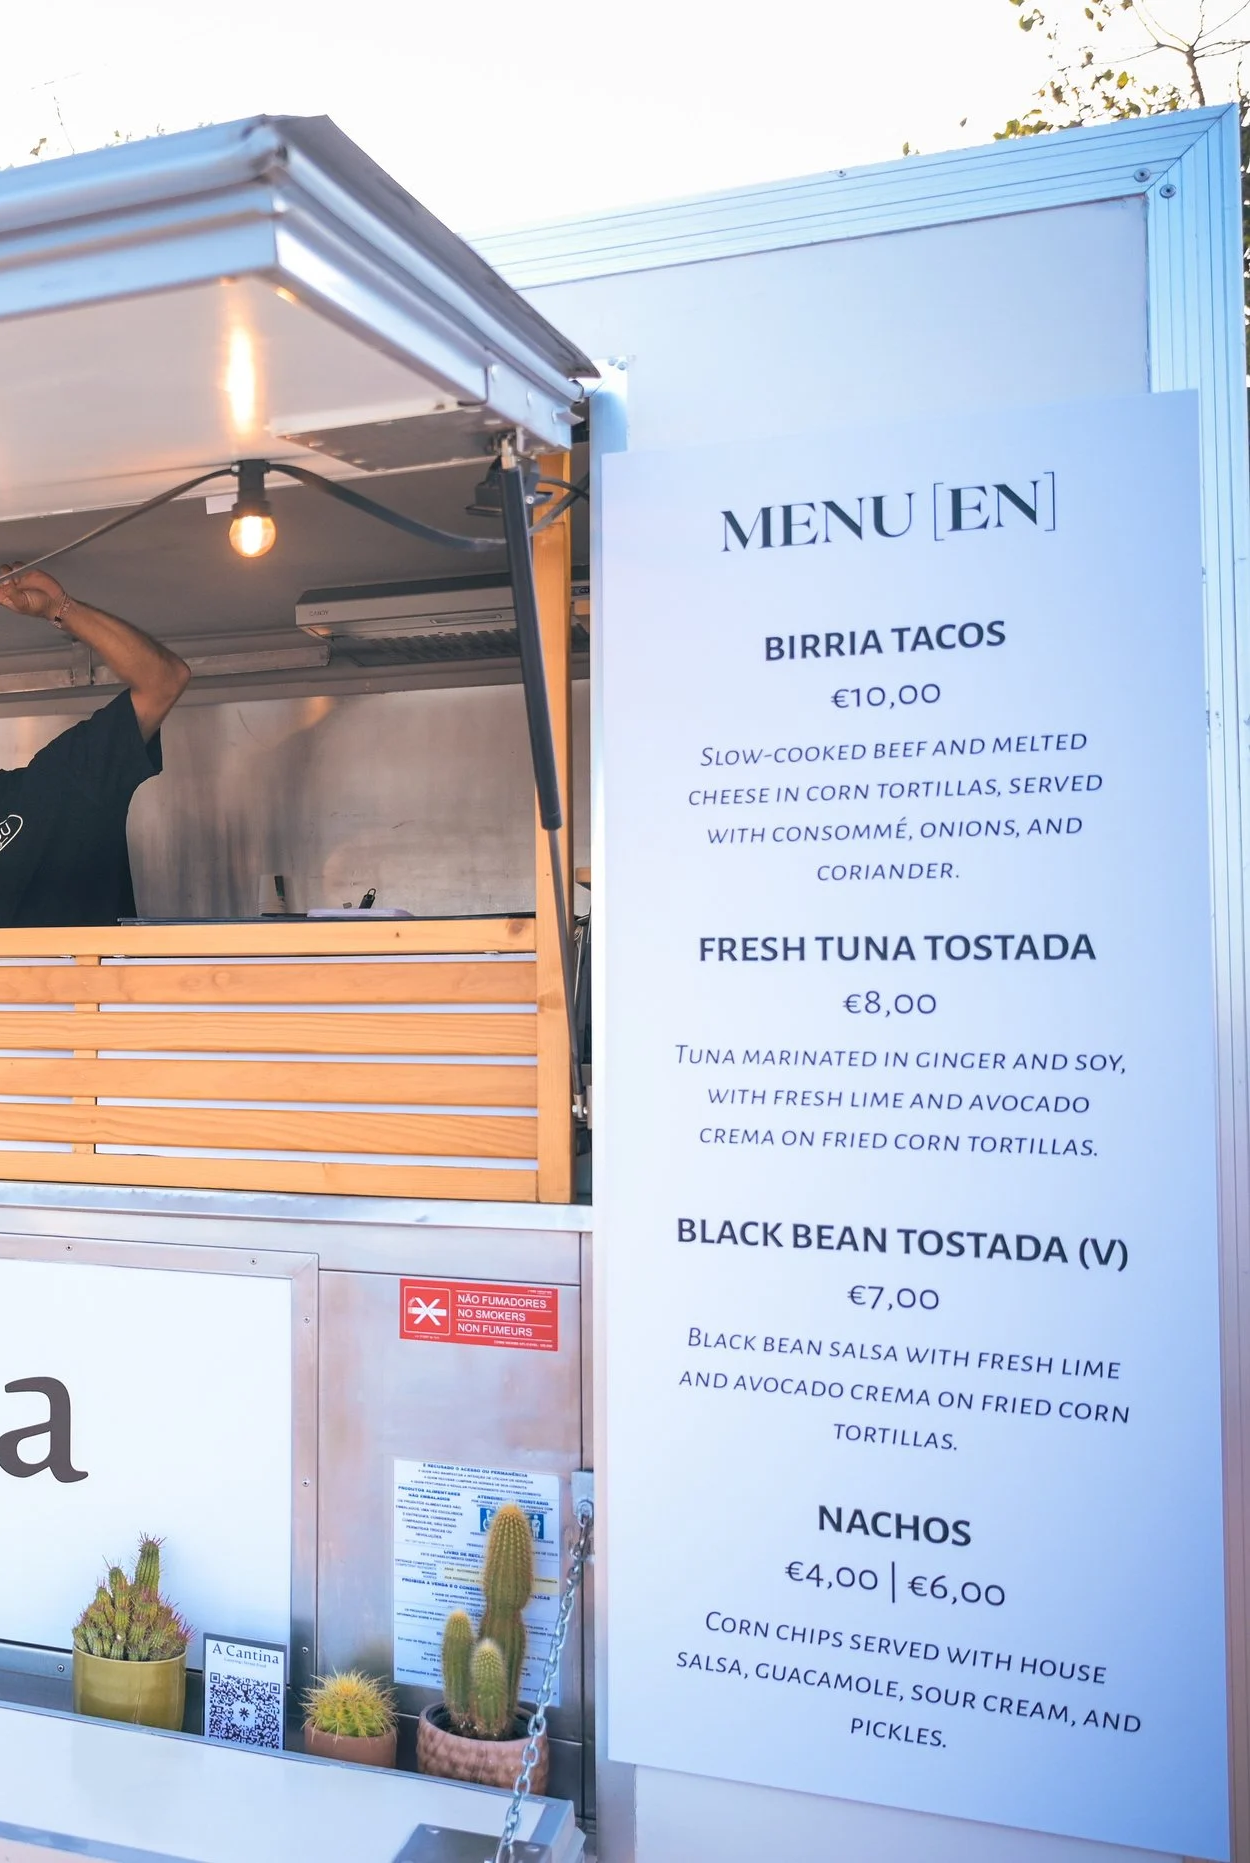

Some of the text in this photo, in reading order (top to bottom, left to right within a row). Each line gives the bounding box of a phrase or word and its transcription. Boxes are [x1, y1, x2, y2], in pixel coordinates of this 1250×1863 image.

[721, 471, 1056, 552] MENU [EN]
[765, 620, 1006, 661] BIRRIA TACOS
[831, 683, 941, 709] €10,00
[700, 733, 1087, 767] SLOW-COOKED BEEF AND MELTED
[688, 774, 1103, 806] CHEESE IN CORN TORTILLAS, SERVED
[707, 816, 1083, 844] WITH CONSOMMÉ, ONIONS, AND
[817, 862, 959, 881] CORIANDER.
[700, 934, 1096, 962] FRESH TUNA TOSTADA
[843, 990, 936, 1018] €8,00
[675, 1044, 1125, 1075] TUNA MARINATED IN GINGER AND SOY,
[708, 1089, 1090, 1113] WITH FRESH LIME AND AVOCADO
[699, 1128, 1097, 1157] CREMA ON FRIED CORN TORTILLAS.
[678, 1218, 1128, 1272] BLACK BEAN TOSTADA (V)
[457, 1293, 547, 1309] NÃO FUMADORES
[847, 1285, 939, 1311] €7,00
[457, 1310, 526, 1322] NO SMOKERS
[457, 1323, 533, 1337] NON FUMEURS
[688, 1327, 1121, 1379] BLACK BEAN SALSA WITH FRESH LIME
[679, 1371, 1129, 1424] AND AVOCADO CREMA ON FRIED CORN
[834, 1423, 957, 1451] TORTILLAS.
[819, 1505, 971, 1547] NACHOS
[785, 1561, 1005, 1606] €4,00 €6,00
[212, 1643, 222, 1654] A
[226, 1645, 279, 1664] Cantina
[706, 1611, 1107, 1684] CORN CHIPS SERVED WITH HOUSE
[676, 1651, 1141, 1733] SALSA, GUACAMOLE, SOUR CREAM, AND
[851, 1717, 946, 1748] PICKLES.
